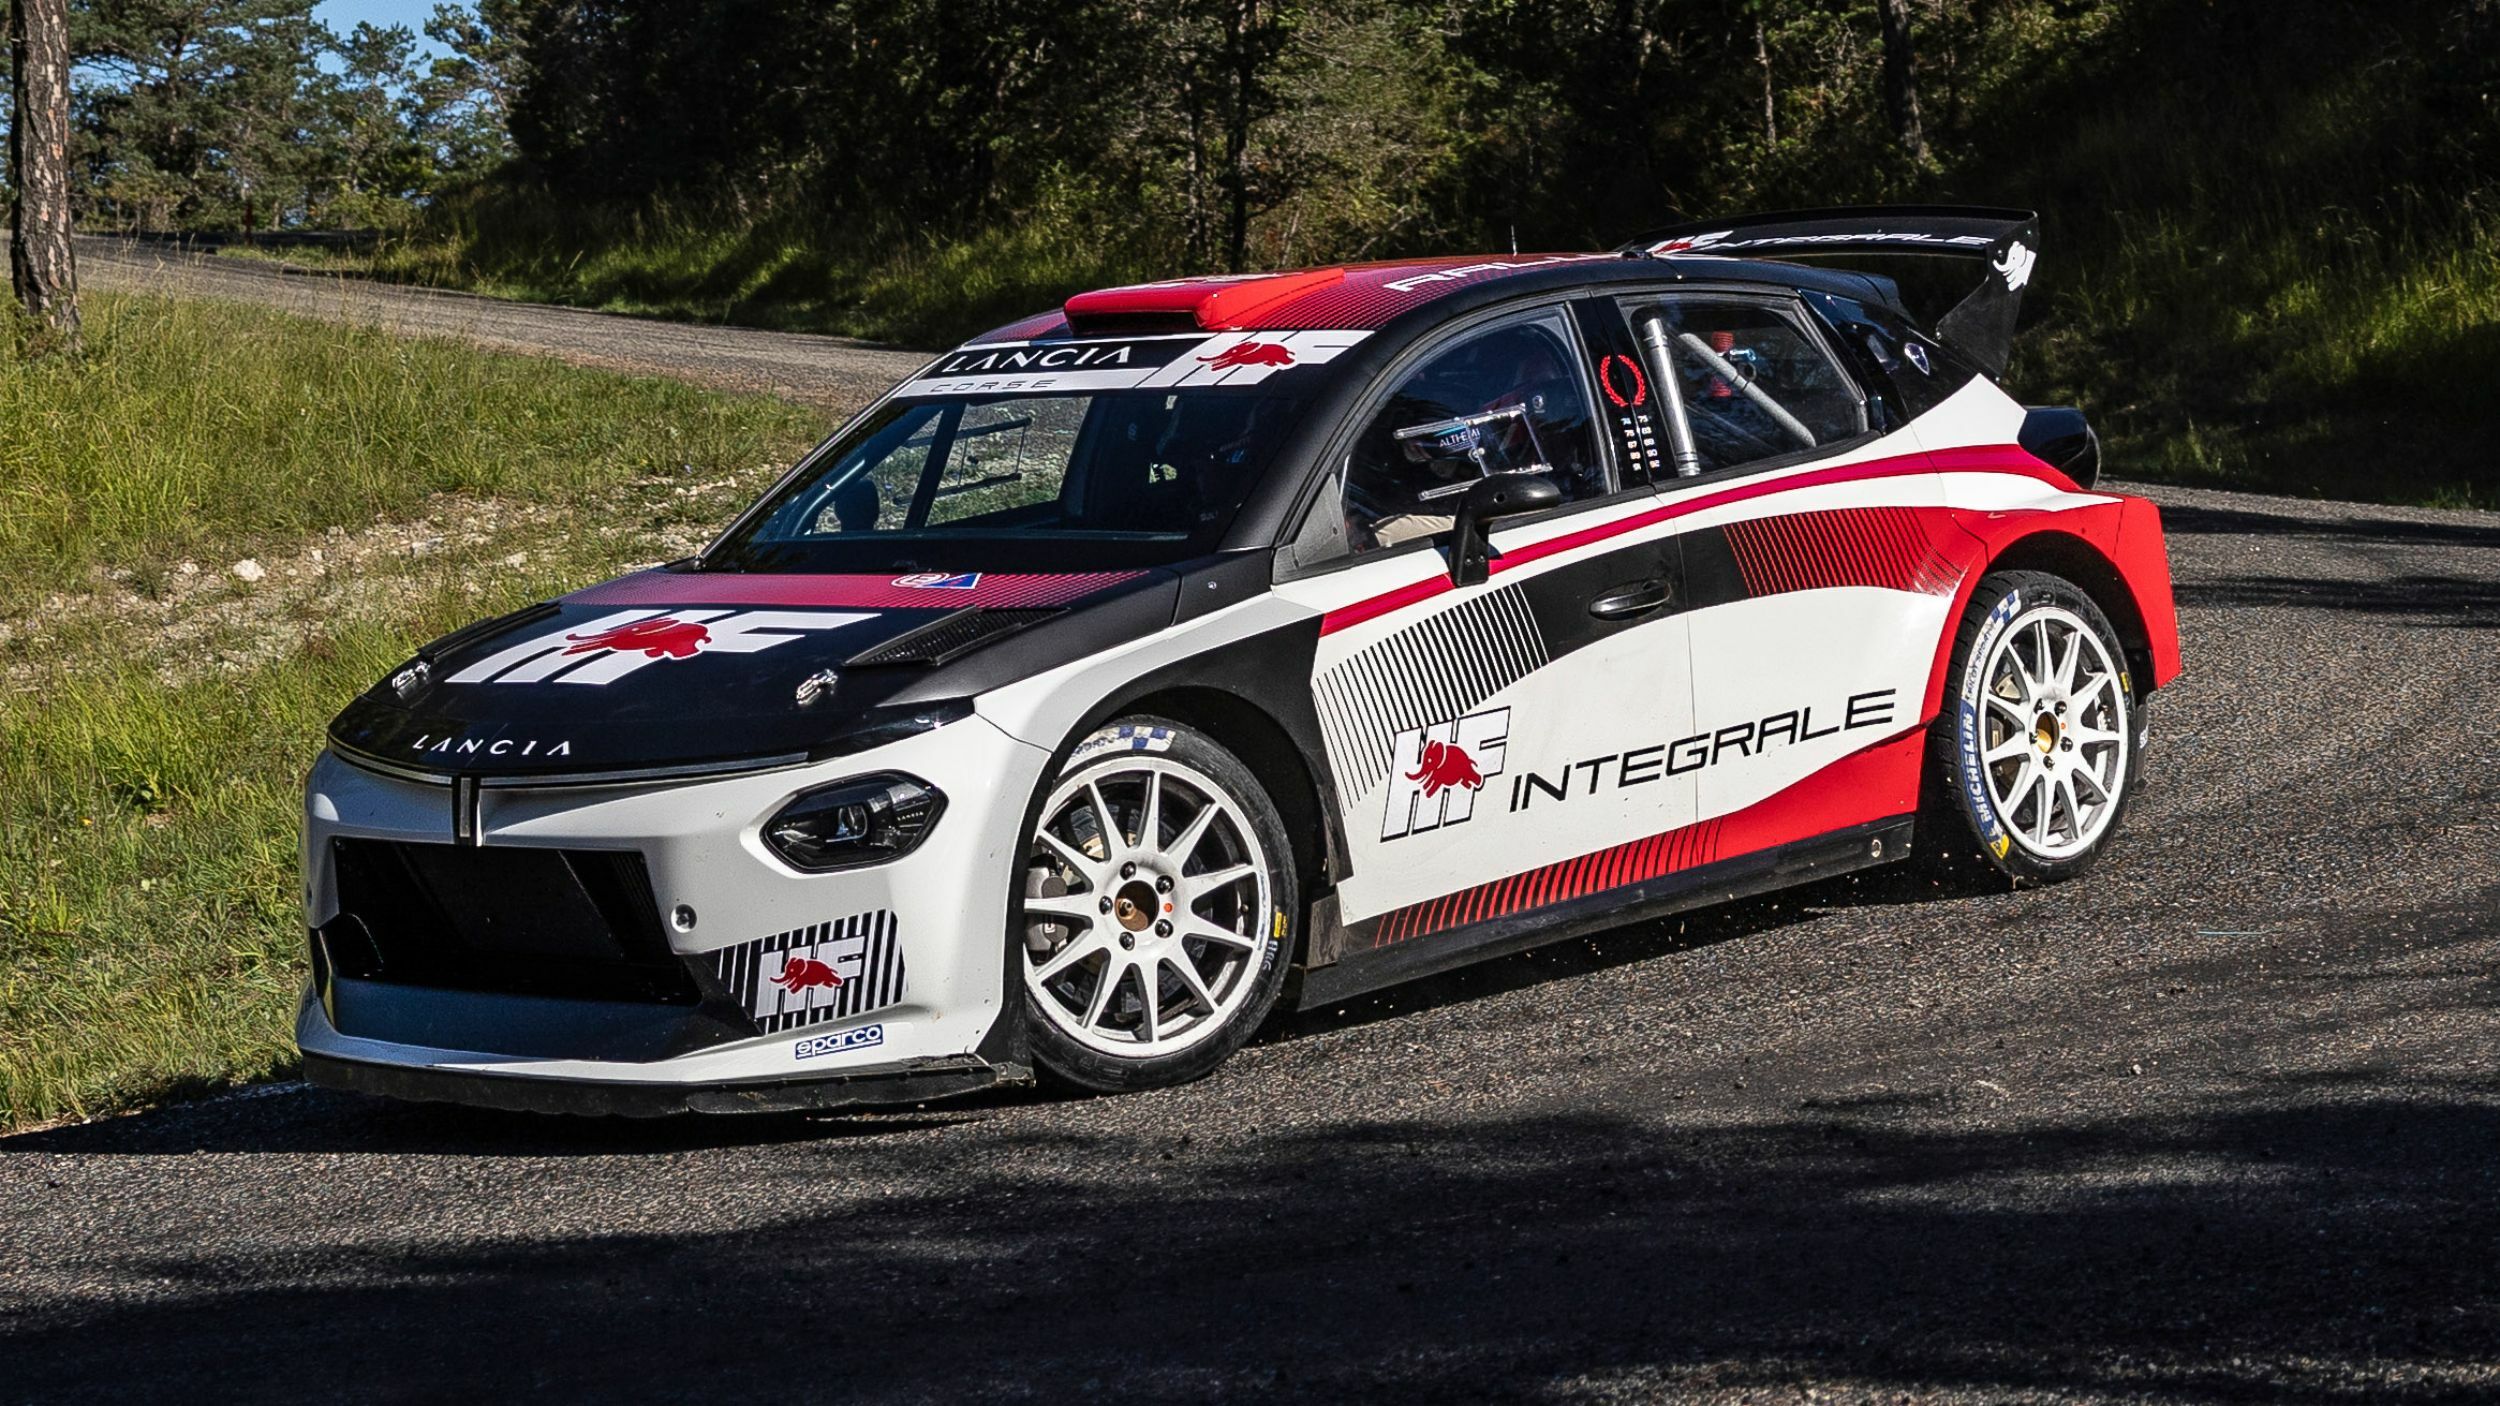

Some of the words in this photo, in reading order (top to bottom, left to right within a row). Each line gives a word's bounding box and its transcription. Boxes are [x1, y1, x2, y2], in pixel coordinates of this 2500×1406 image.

[941, 346, 1131, 373] LANCIA
[930, 378, 1059, 393] CORSE
[412, 734, 571, 756] LANCIA
[1509, 688, 1897, 812] INTEGRALE
[1962, 713, 1993, 824] MICHELIN
[797, 1026, 881, 1056] sparco
